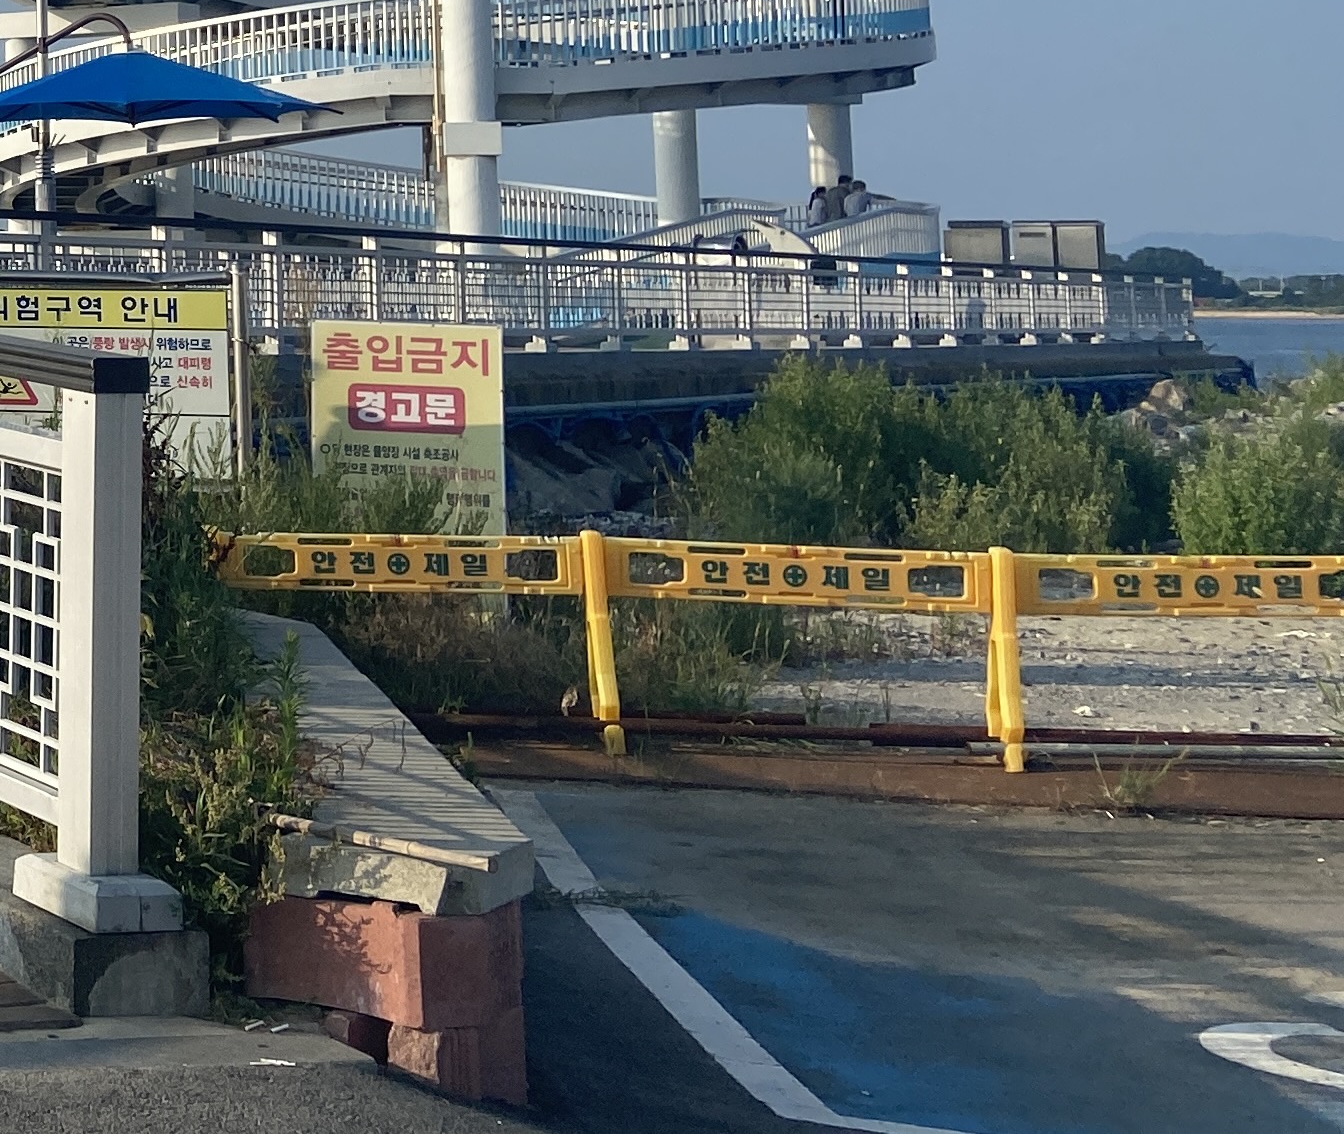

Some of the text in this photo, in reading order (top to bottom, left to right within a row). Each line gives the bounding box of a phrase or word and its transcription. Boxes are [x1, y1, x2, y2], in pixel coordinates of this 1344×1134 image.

[120, 295, 179, 323] 안내
[92, 336, 115, 350] 풍랑
[155, 337, 213, 351] 위험하므로
[322, 332, 490, 377] 출입금지
[177, 356, 212, 370] 대피령
[176, 375, 213, 389] 신속히
[355, 390, 456, 426] 경고문
[344, 443, 371, 458] 현장은
[403, 446, 421, 460] 시설
[311, 551, 489, 578] 안전 제일
[702, 560, 891, 591] 안전 제일
[1113, 572, 1304, 599] 안전 제일
